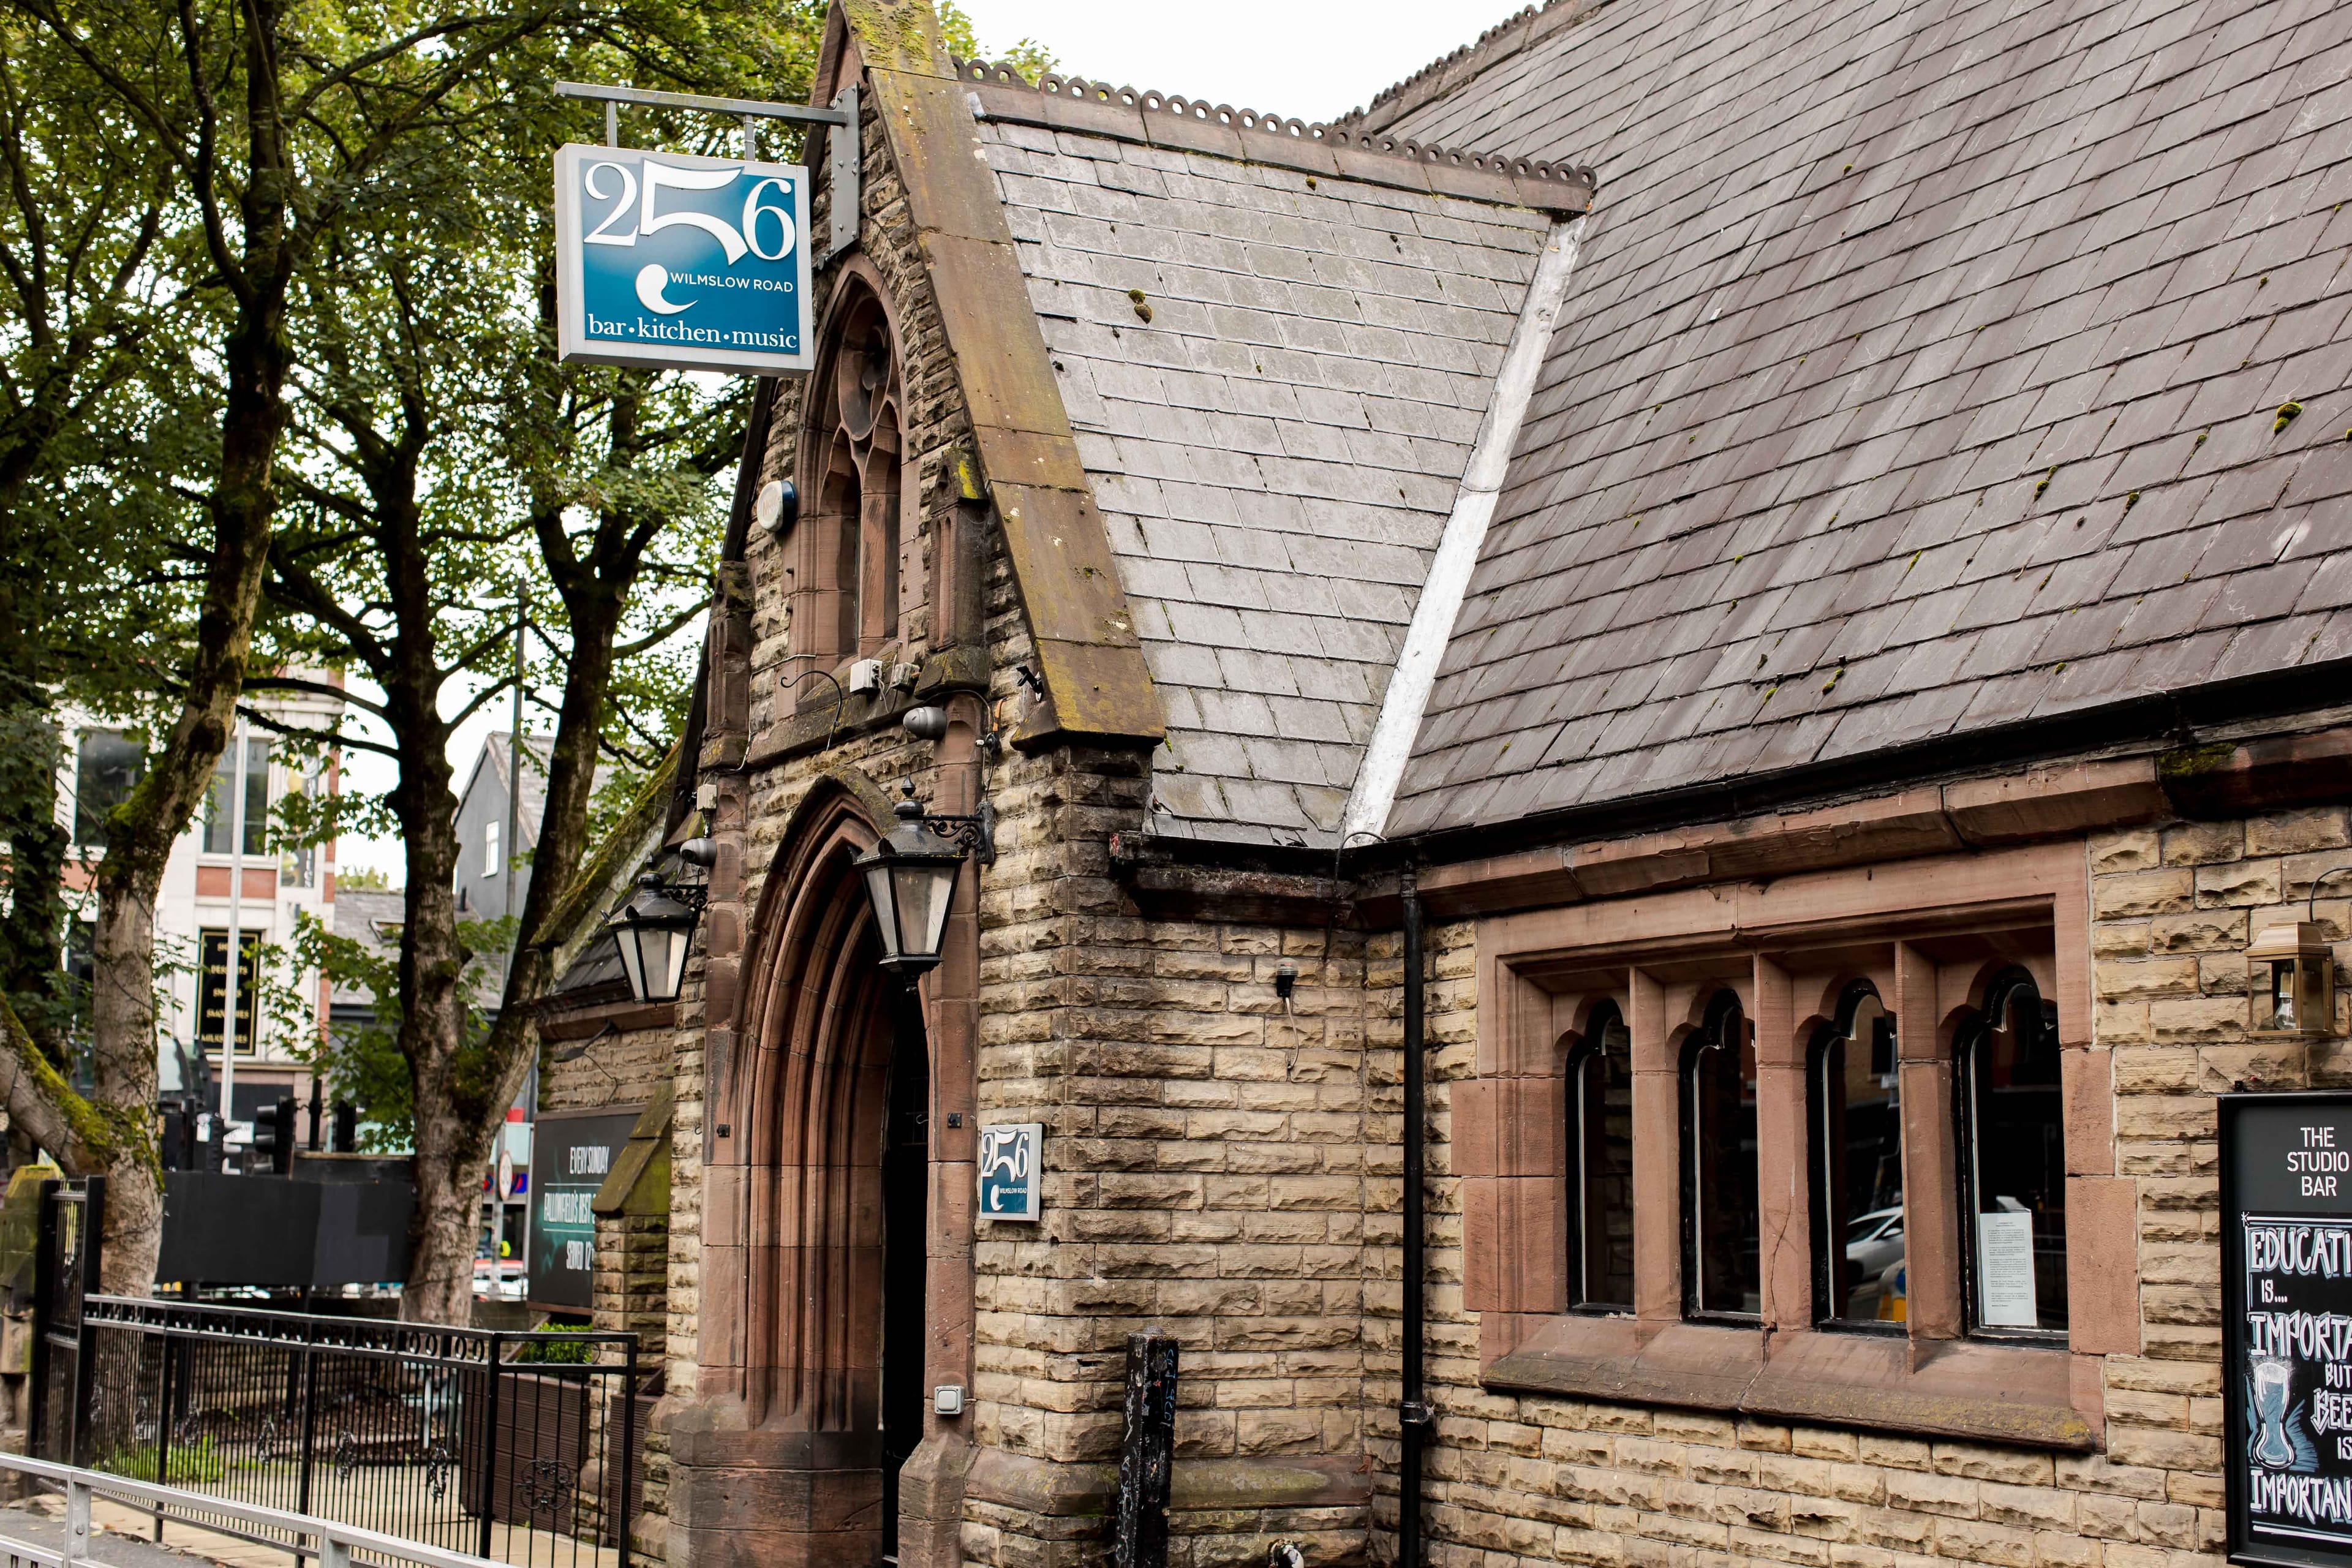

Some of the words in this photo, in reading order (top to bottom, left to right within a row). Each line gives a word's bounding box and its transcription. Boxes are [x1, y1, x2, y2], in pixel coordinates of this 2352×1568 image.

[584, 159, 796, 266] 256
[670, 272, 749, 288] WILMSLOW
[753, 281, 793, 292] ROAD
[588, 314, 627, 335] bar
[637, 318, 720, 342] kitchen
[732, 328, 797, 349] music
[211, 965, 247, 975] DESTS
[201, 1034, 247, 1043] MILKSKES
[2300, 1127, 2334, 1147] THE
[570, 1146, 588, 1174] EVERY
[587, 1146, 609, 1174] SUNDAY
[981, 1128, 1028, 1182] 256
[2287, 1152, 2350, 1172] STUDIO
[2302, 1176, 2337, 1196] BAR
[2250, 1227, 2352, 1278] EDUCATI
[2325, 1362, 2352, 1388] BUT
[2337, 1436, 2352, 1460] IS
[2250, 1470, 2352, 1525] IMPORTAN
